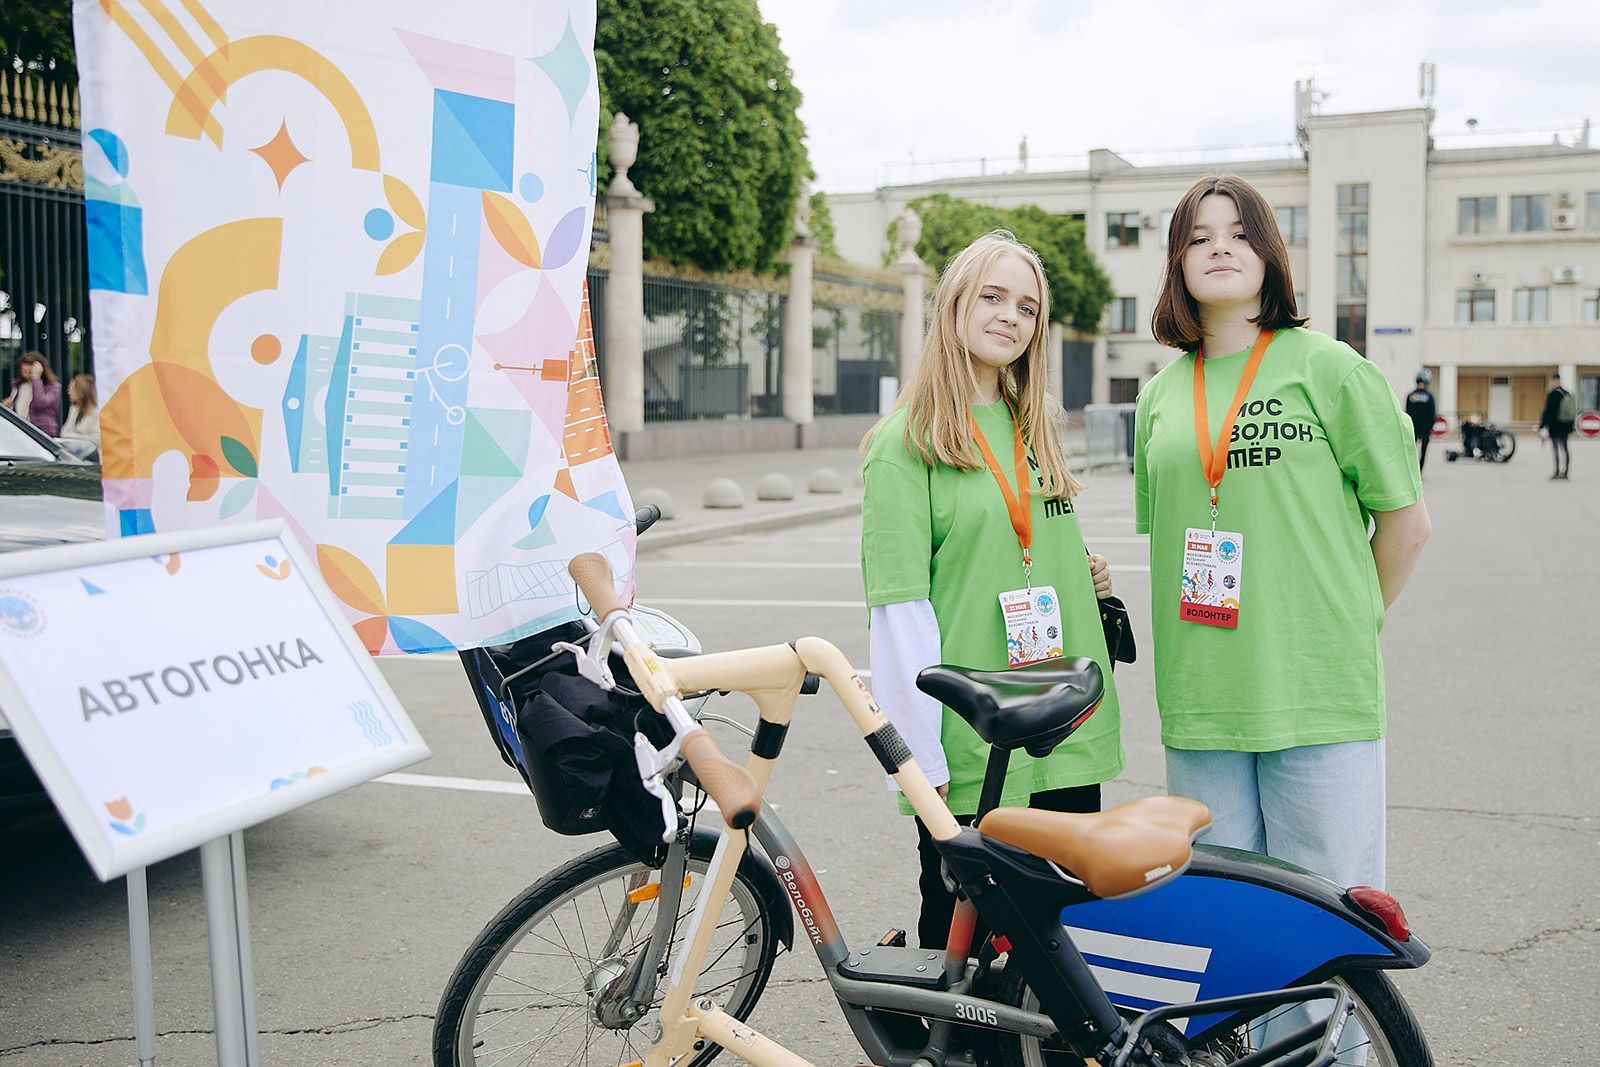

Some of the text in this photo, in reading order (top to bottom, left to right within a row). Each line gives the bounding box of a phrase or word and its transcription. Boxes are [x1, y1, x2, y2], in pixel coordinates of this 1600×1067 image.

[1187, 608, 1232, 621] ВОЛОНТЕР
[77, 637, 324, 722] АВТОГОНКА
[783, 871, 823, 945] Велобайк
[955, 1002, 998, 1026] 3005
